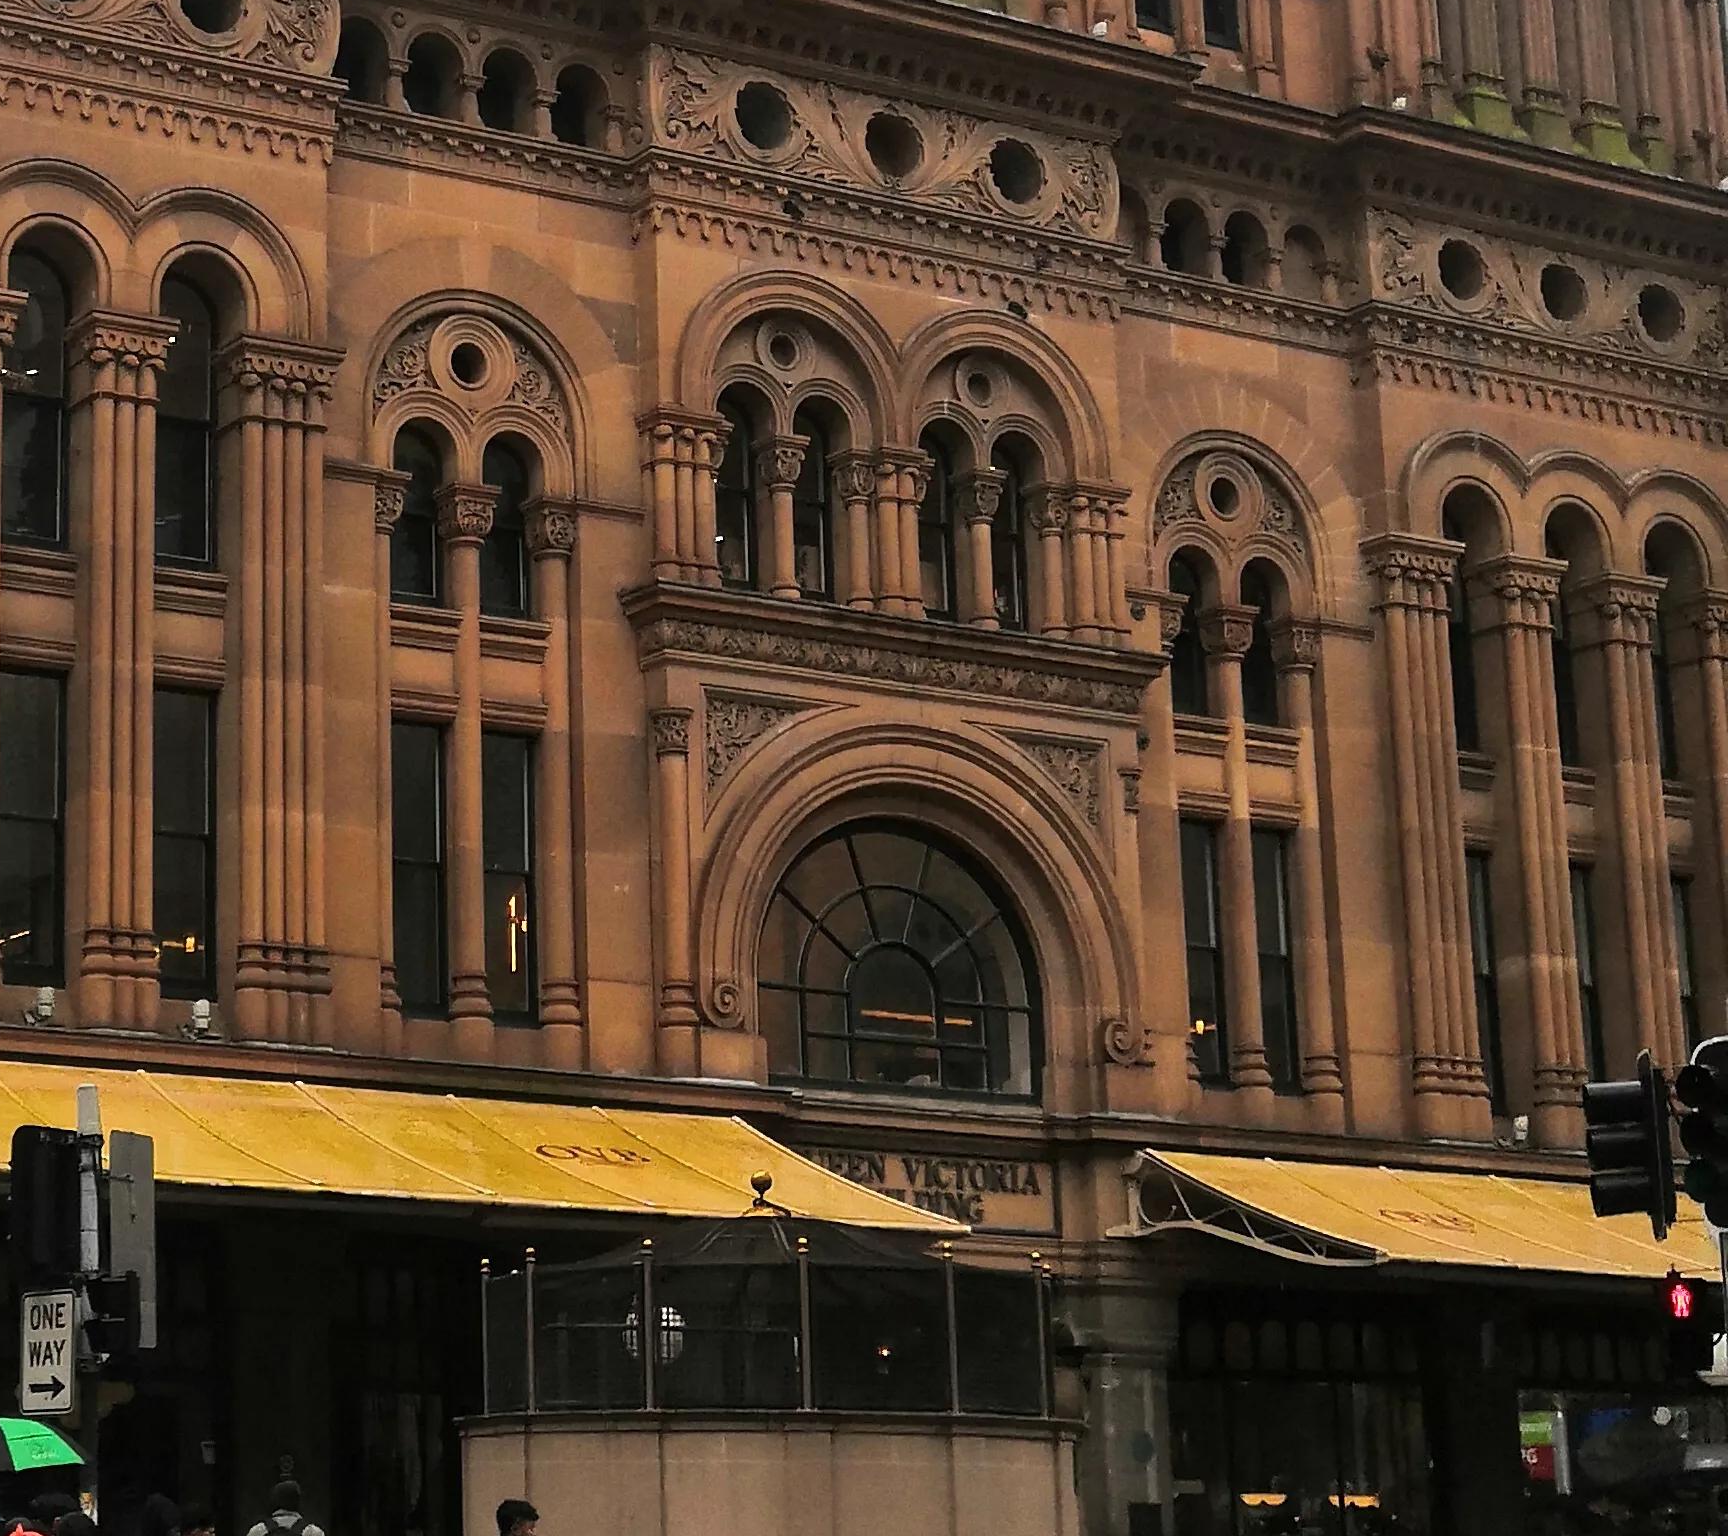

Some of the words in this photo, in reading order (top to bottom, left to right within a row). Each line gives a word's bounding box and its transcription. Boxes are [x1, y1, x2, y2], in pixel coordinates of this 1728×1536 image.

[901, 1156, 1041, 1196] VICTORIA
[30, 1302, 66, 1331] ONE
[28, 1339, 66, 1368] WAY
